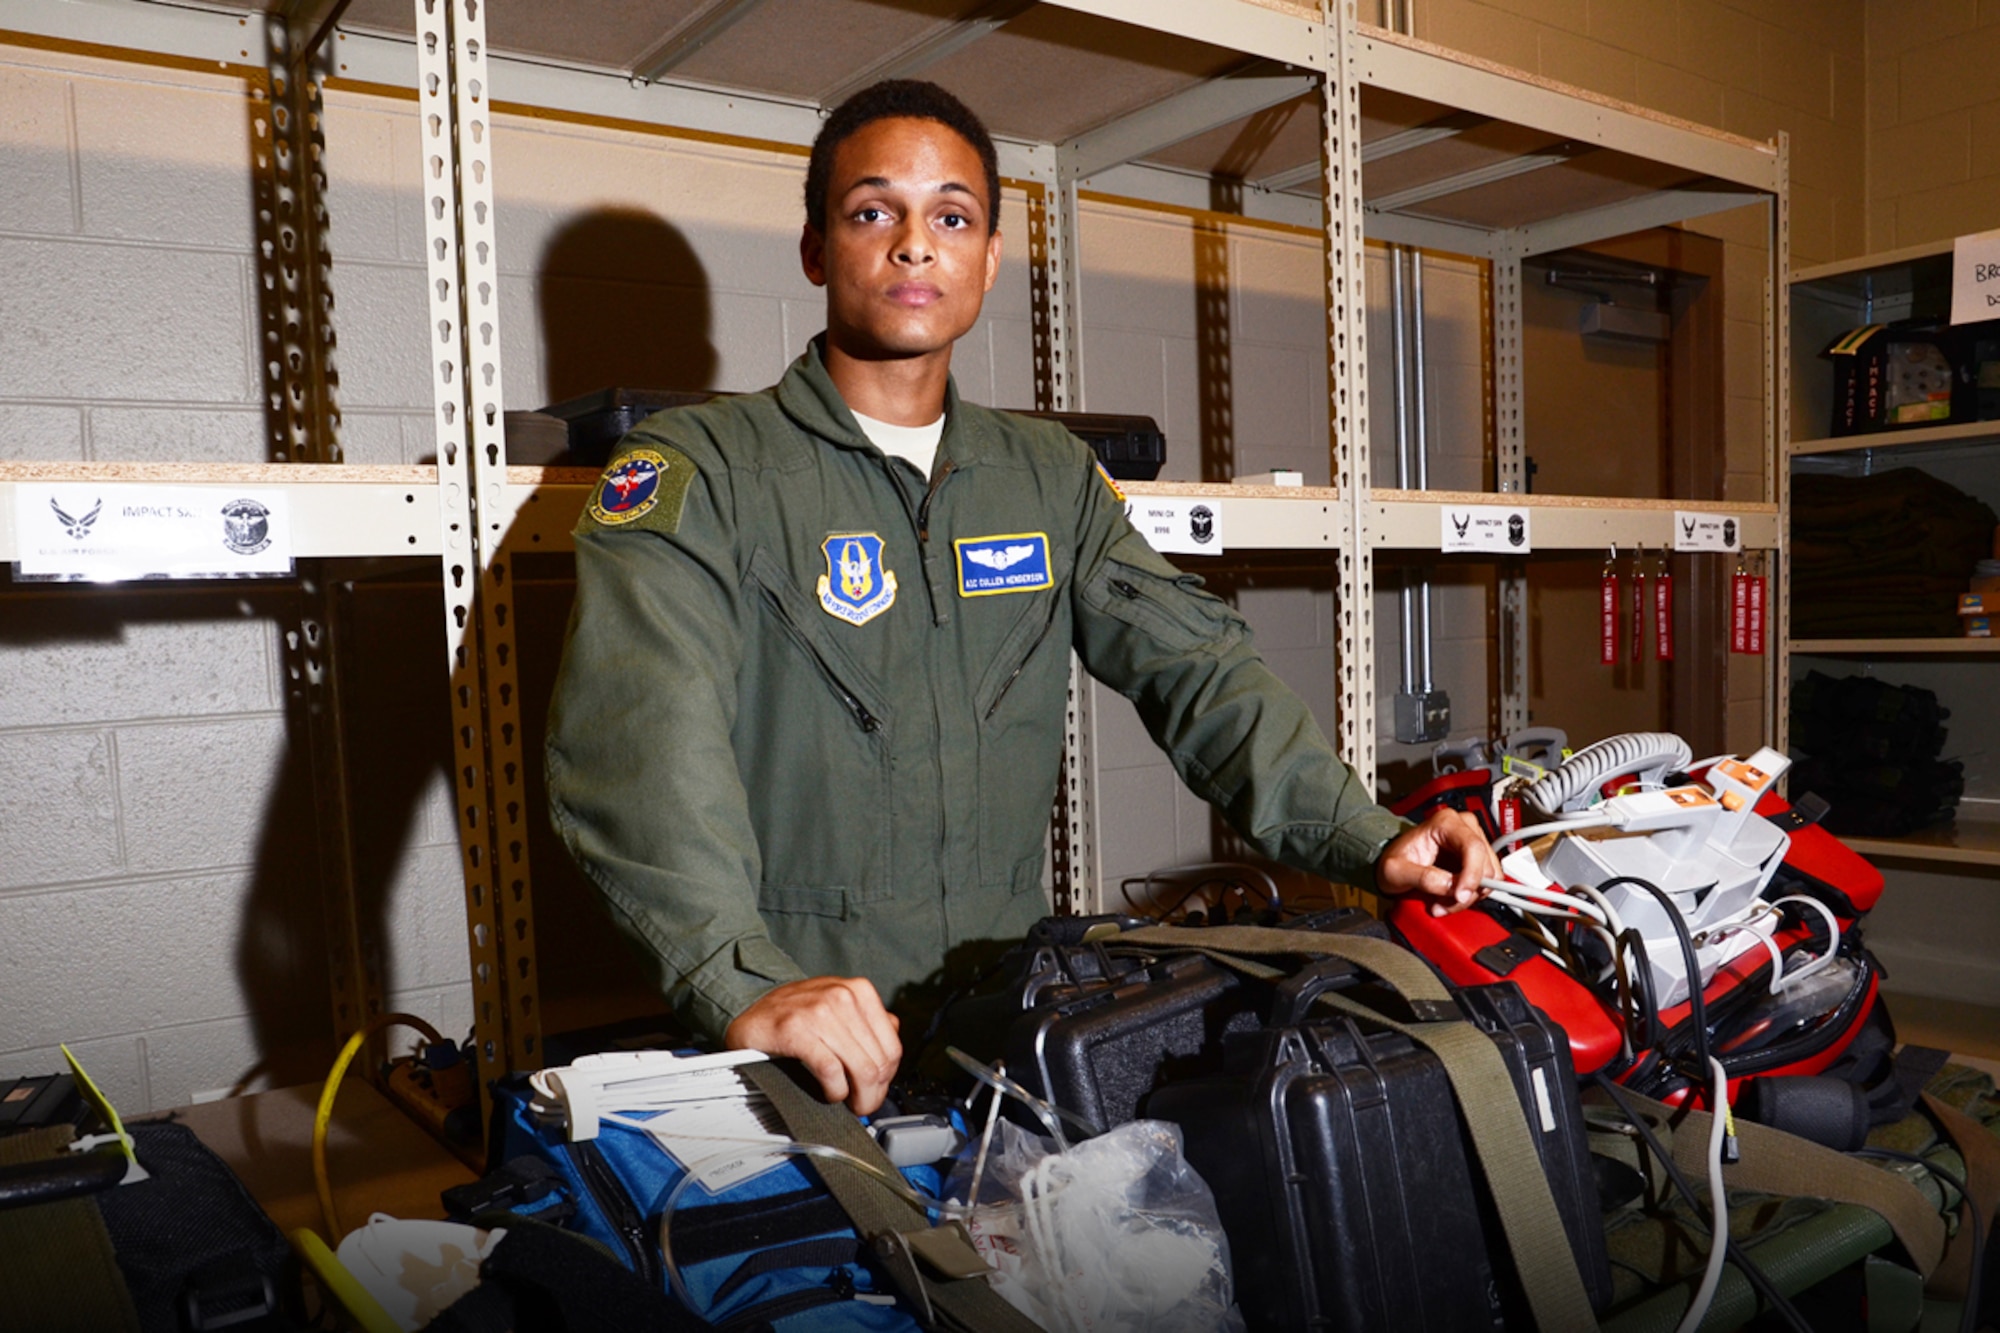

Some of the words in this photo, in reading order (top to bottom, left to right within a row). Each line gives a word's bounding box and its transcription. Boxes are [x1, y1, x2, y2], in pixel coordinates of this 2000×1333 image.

[1869, 356, 1878, 417] IMPACT
[122, 506, 172, 518] IMPACT
[979, 575, 1005, 587] CULLEN
[1005, 572, 1045, 584] HENDERSON
